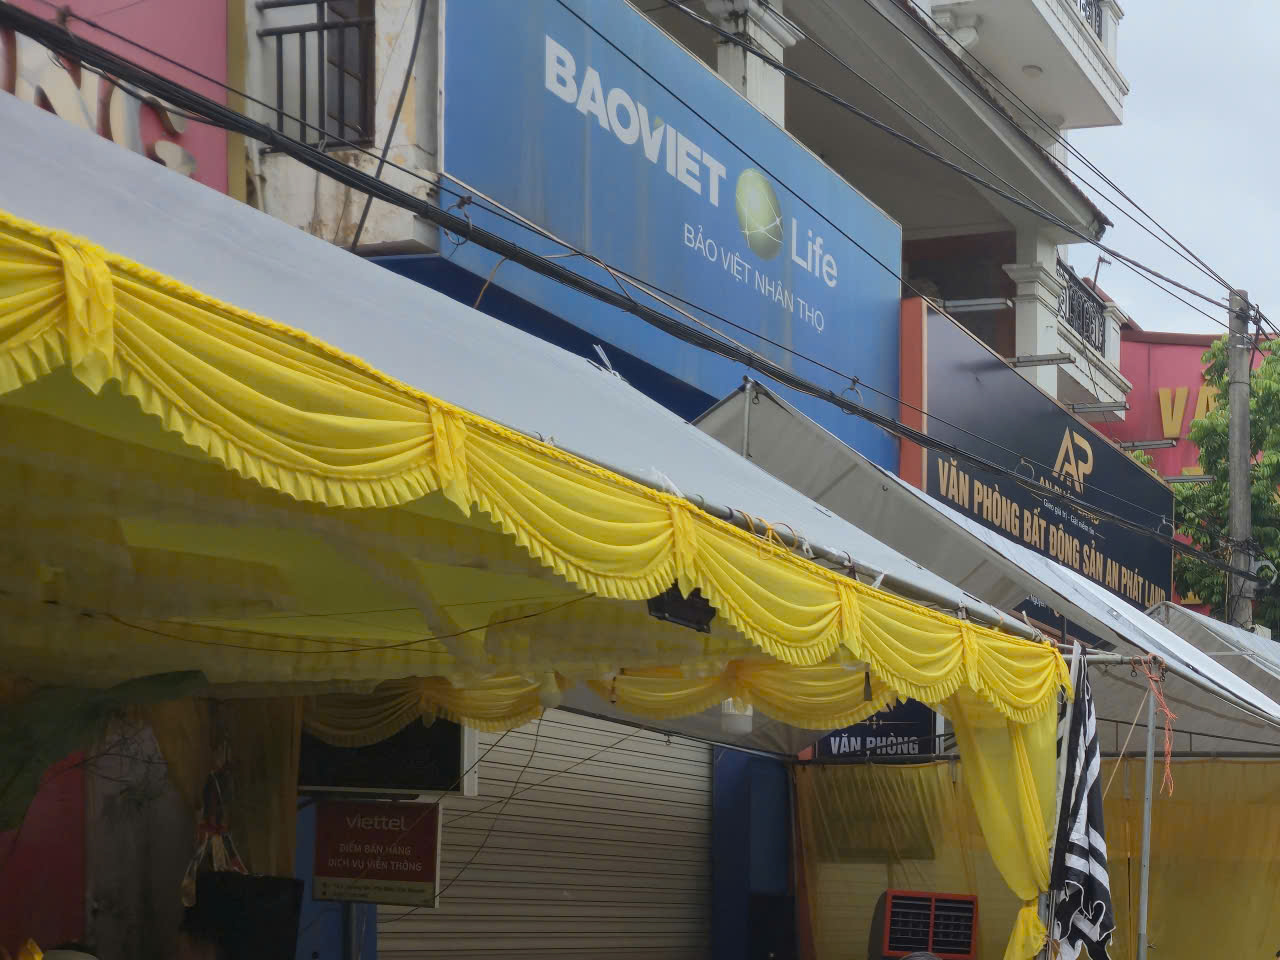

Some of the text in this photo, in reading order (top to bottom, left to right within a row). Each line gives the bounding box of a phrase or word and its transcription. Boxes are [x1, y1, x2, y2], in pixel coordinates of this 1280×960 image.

[544, 33, 727, 208] BAOVIET
[684, 223, 825, 334] BẢO VIỆT NHÂN THỌ
[791, 216, 838, 288] Life
[938, 458, 970, 509] VĂN
[974, 479, 1021, 537] PHÒNG
[1023, 507, 1047, 550] BẤT
[1049, 523, 1080, 570] ĐỘNG
[1082, 539, 1104, 582] SẢN
[1105, 557, 1119, 592] AN
[1121, 568, 1144, 603] PHÁT
[830, 732, 919, 755] VĂN PHÒNG
[345, 815, 409, 832] viettel
